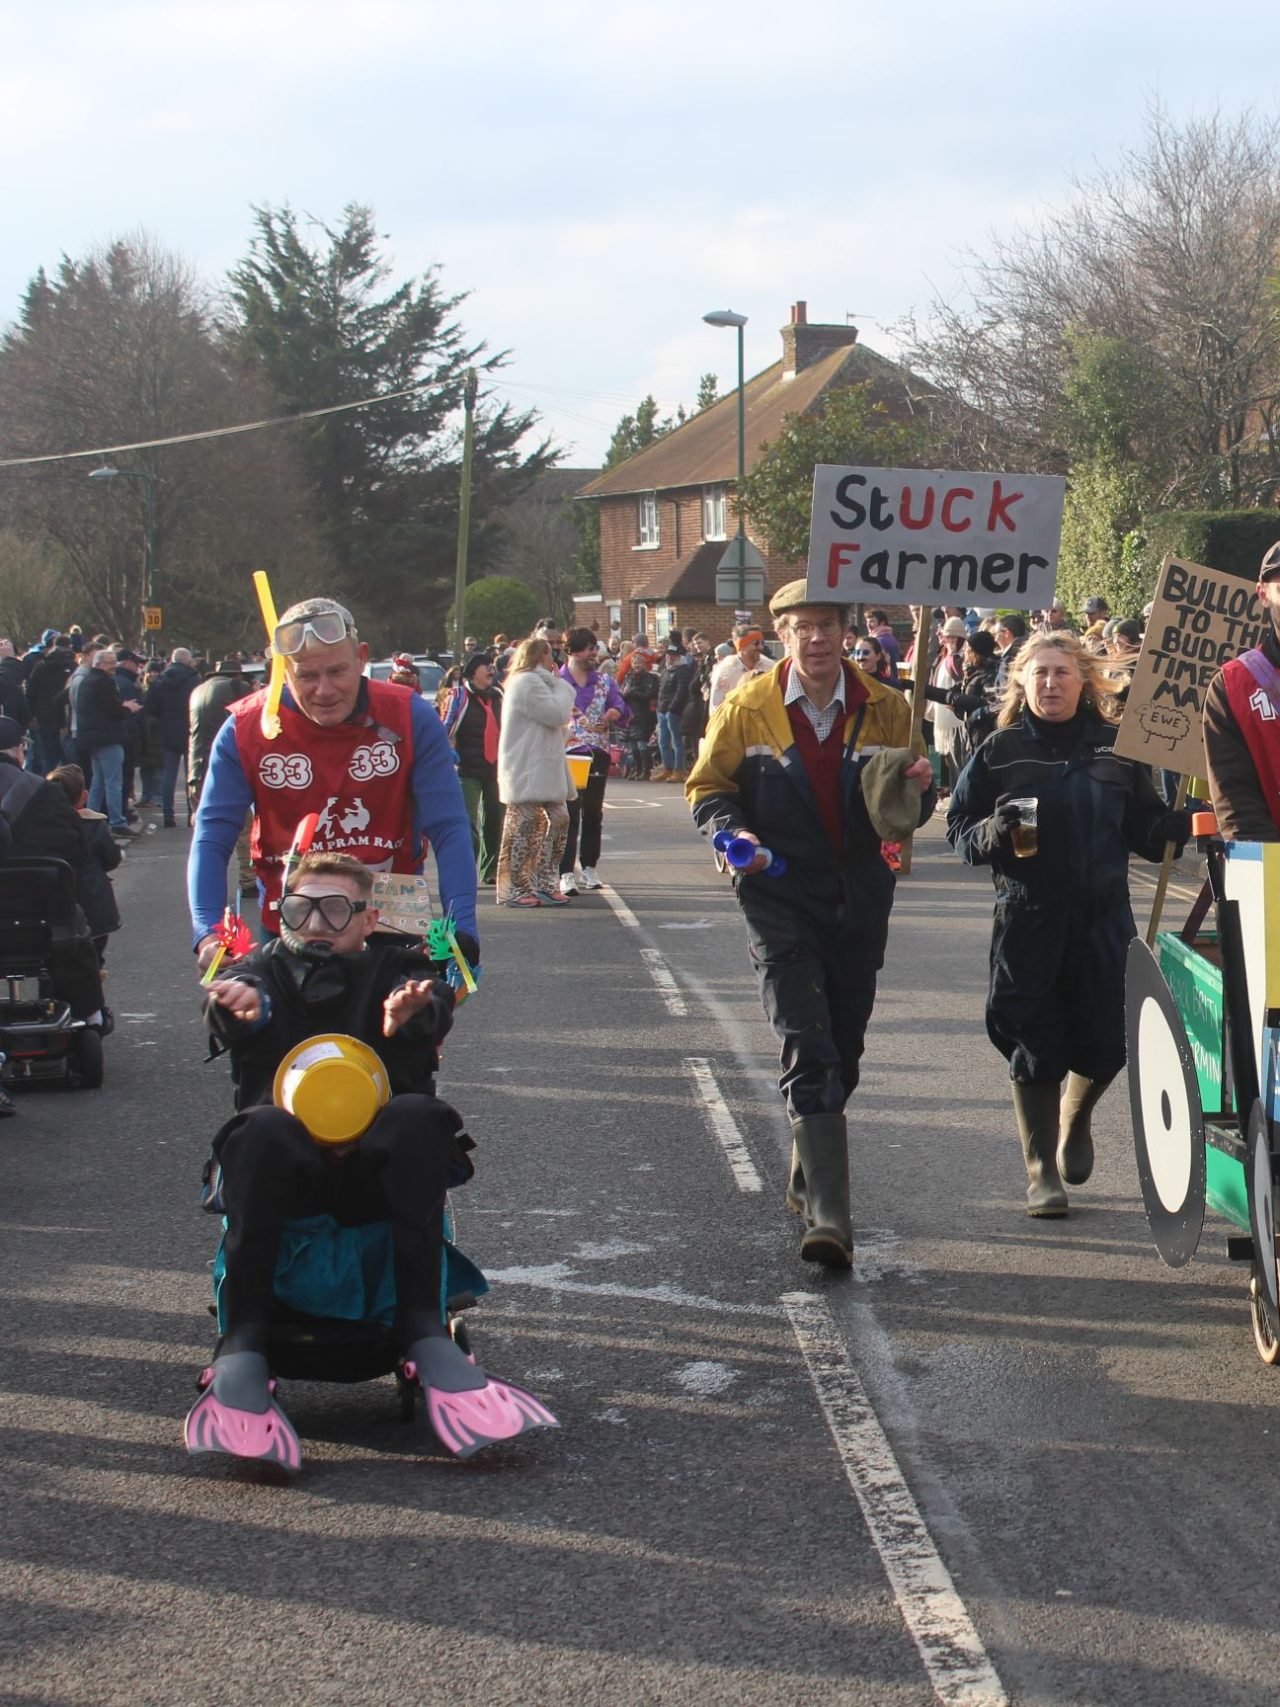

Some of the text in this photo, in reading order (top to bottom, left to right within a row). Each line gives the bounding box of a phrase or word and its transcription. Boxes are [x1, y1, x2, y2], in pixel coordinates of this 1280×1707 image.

[827, 542, 1050, 594] Farmer
[147, 614, 160, 625] 30
[1175, 604, 1211, 633] TO
[1161, 625, 1250, 667] BUDG
[1152, 679, 1205, 714] MA
[1151, 711, 1181, 728] EWE
[259, 753, 313, 790] 33
[348, 741, 400, 781] 33
[327, 835, 370, 851] PRAM
